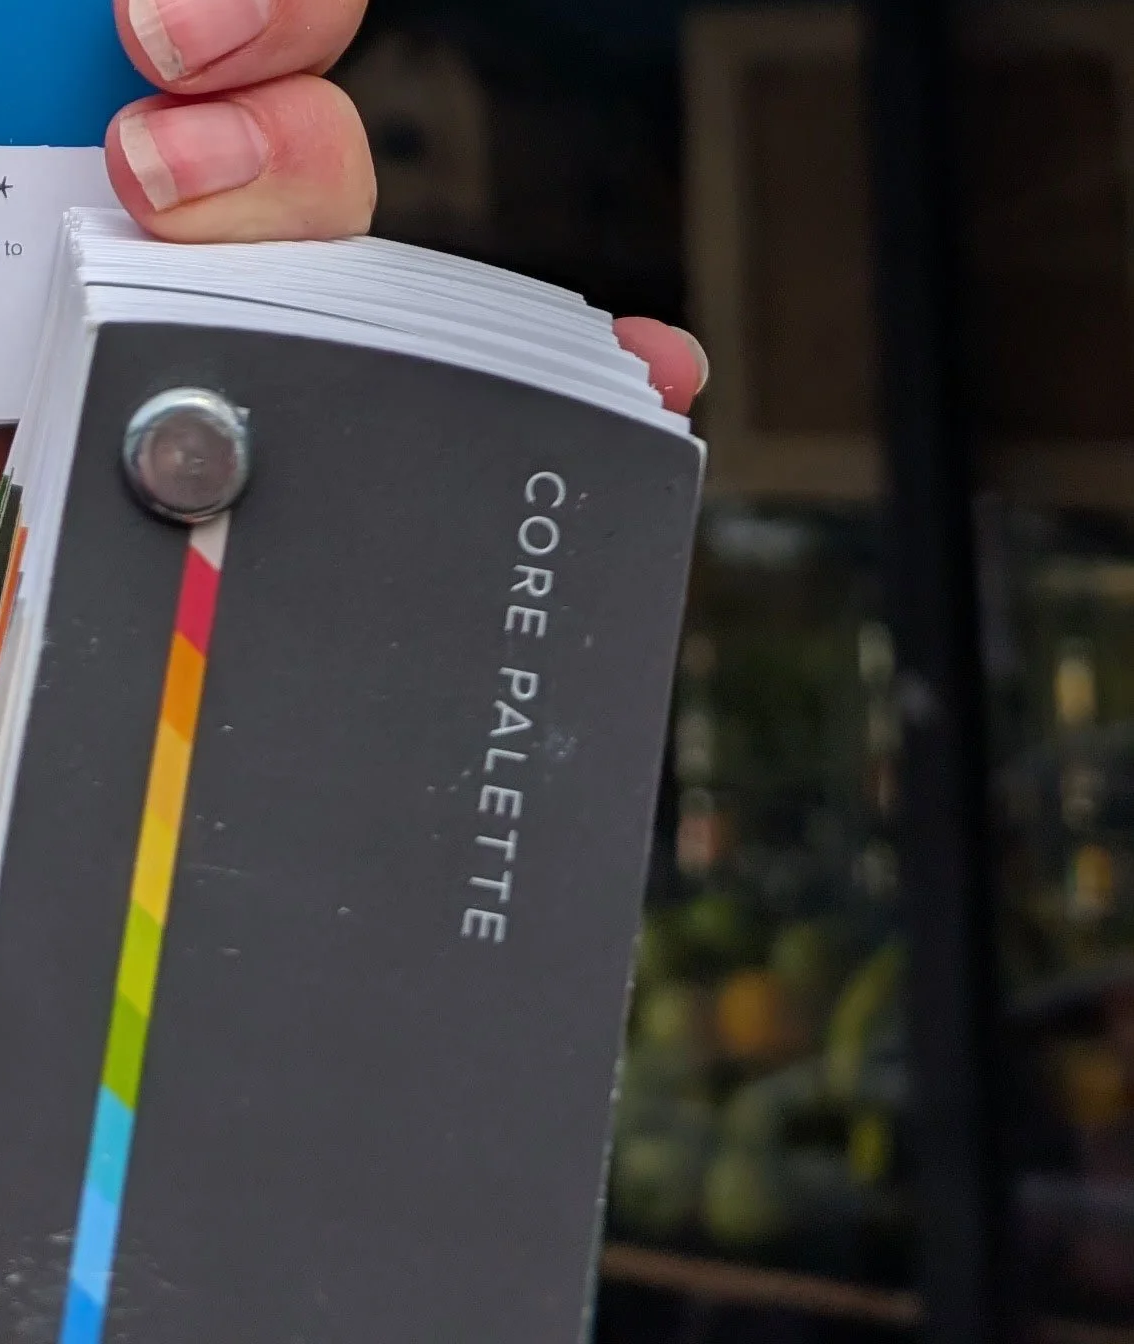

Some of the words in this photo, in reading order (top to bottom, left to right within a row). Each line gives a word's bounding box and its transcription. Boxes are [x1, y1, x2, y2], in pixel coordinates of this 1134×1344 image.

[4, 240, 23, 257] to
[503, 469, 566, 638] CORE
[460, 665, 539, 944] PALETTE
